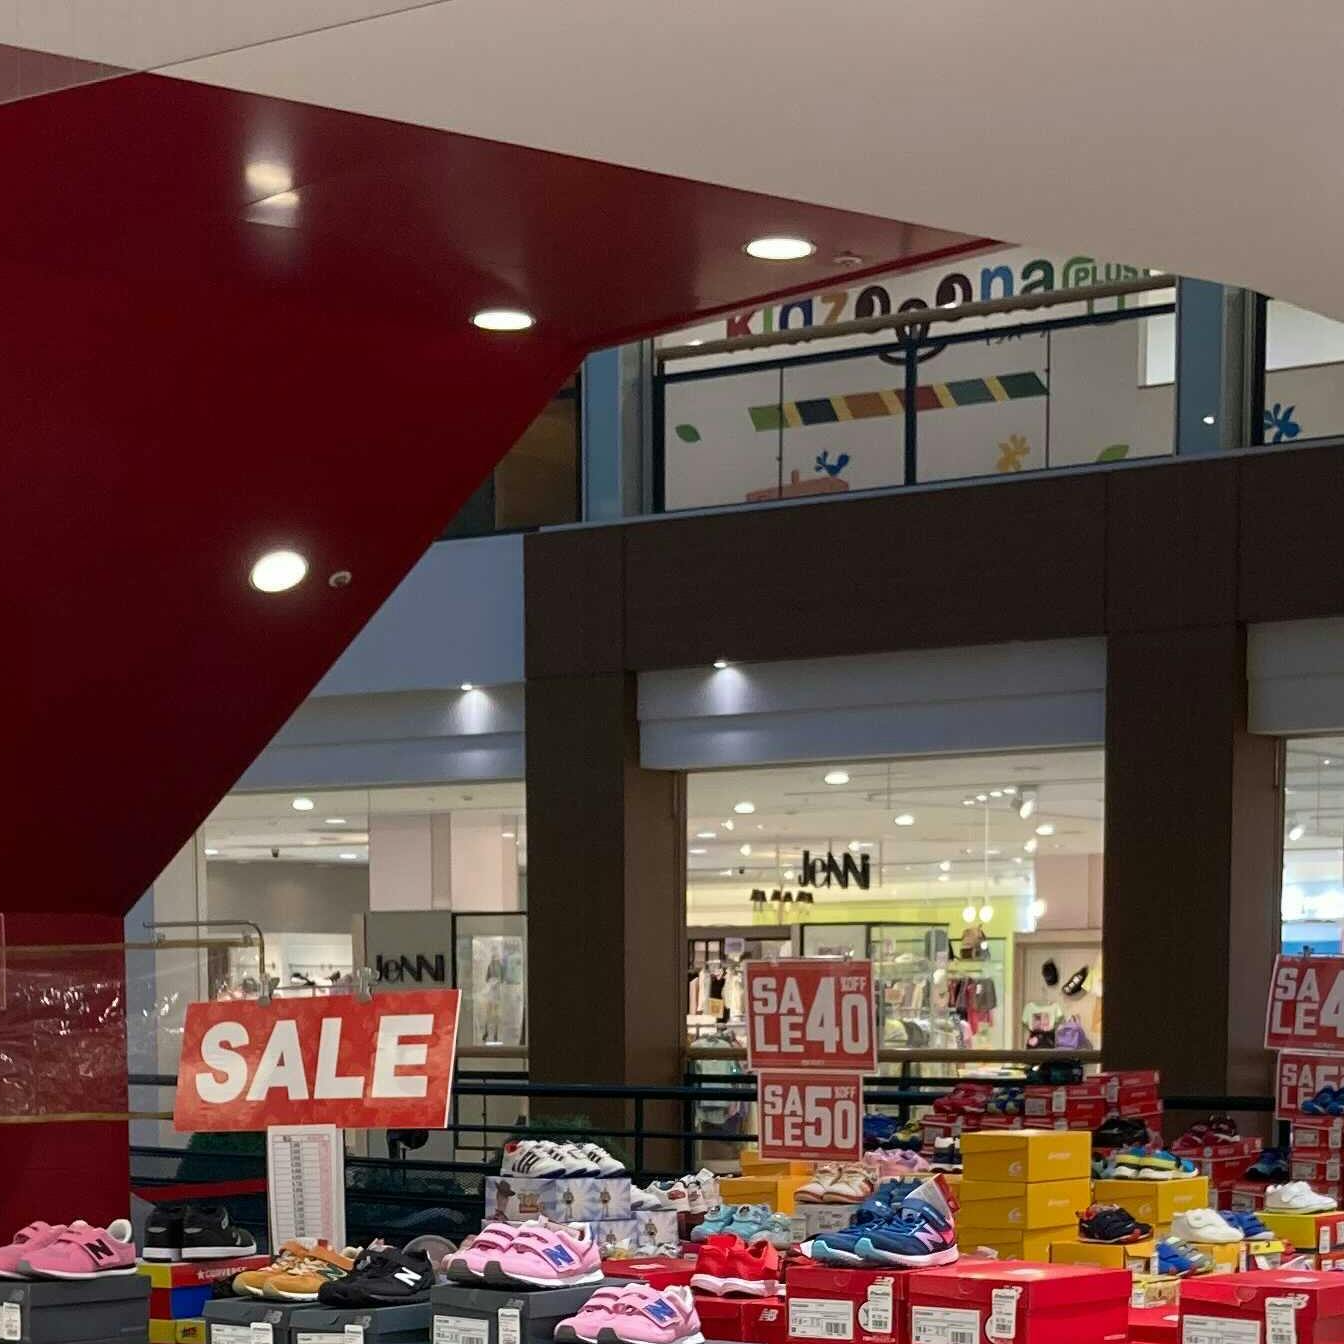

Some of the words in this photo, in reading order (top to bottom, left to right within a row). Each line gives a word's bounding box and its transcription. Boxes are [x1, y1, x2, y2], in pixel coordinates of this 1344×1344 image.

[751, 976, 805, 1014] SA
[1275, 968, 1320, 1001] SA
[805, 976, 870, 1055] 40
[195, 1014, 434, 1104] SALE
[1282, 1063, 1315, 1088] SA
[763, 1084, 804, 1116] SA
[803, 1085, 857, 1149] 50
